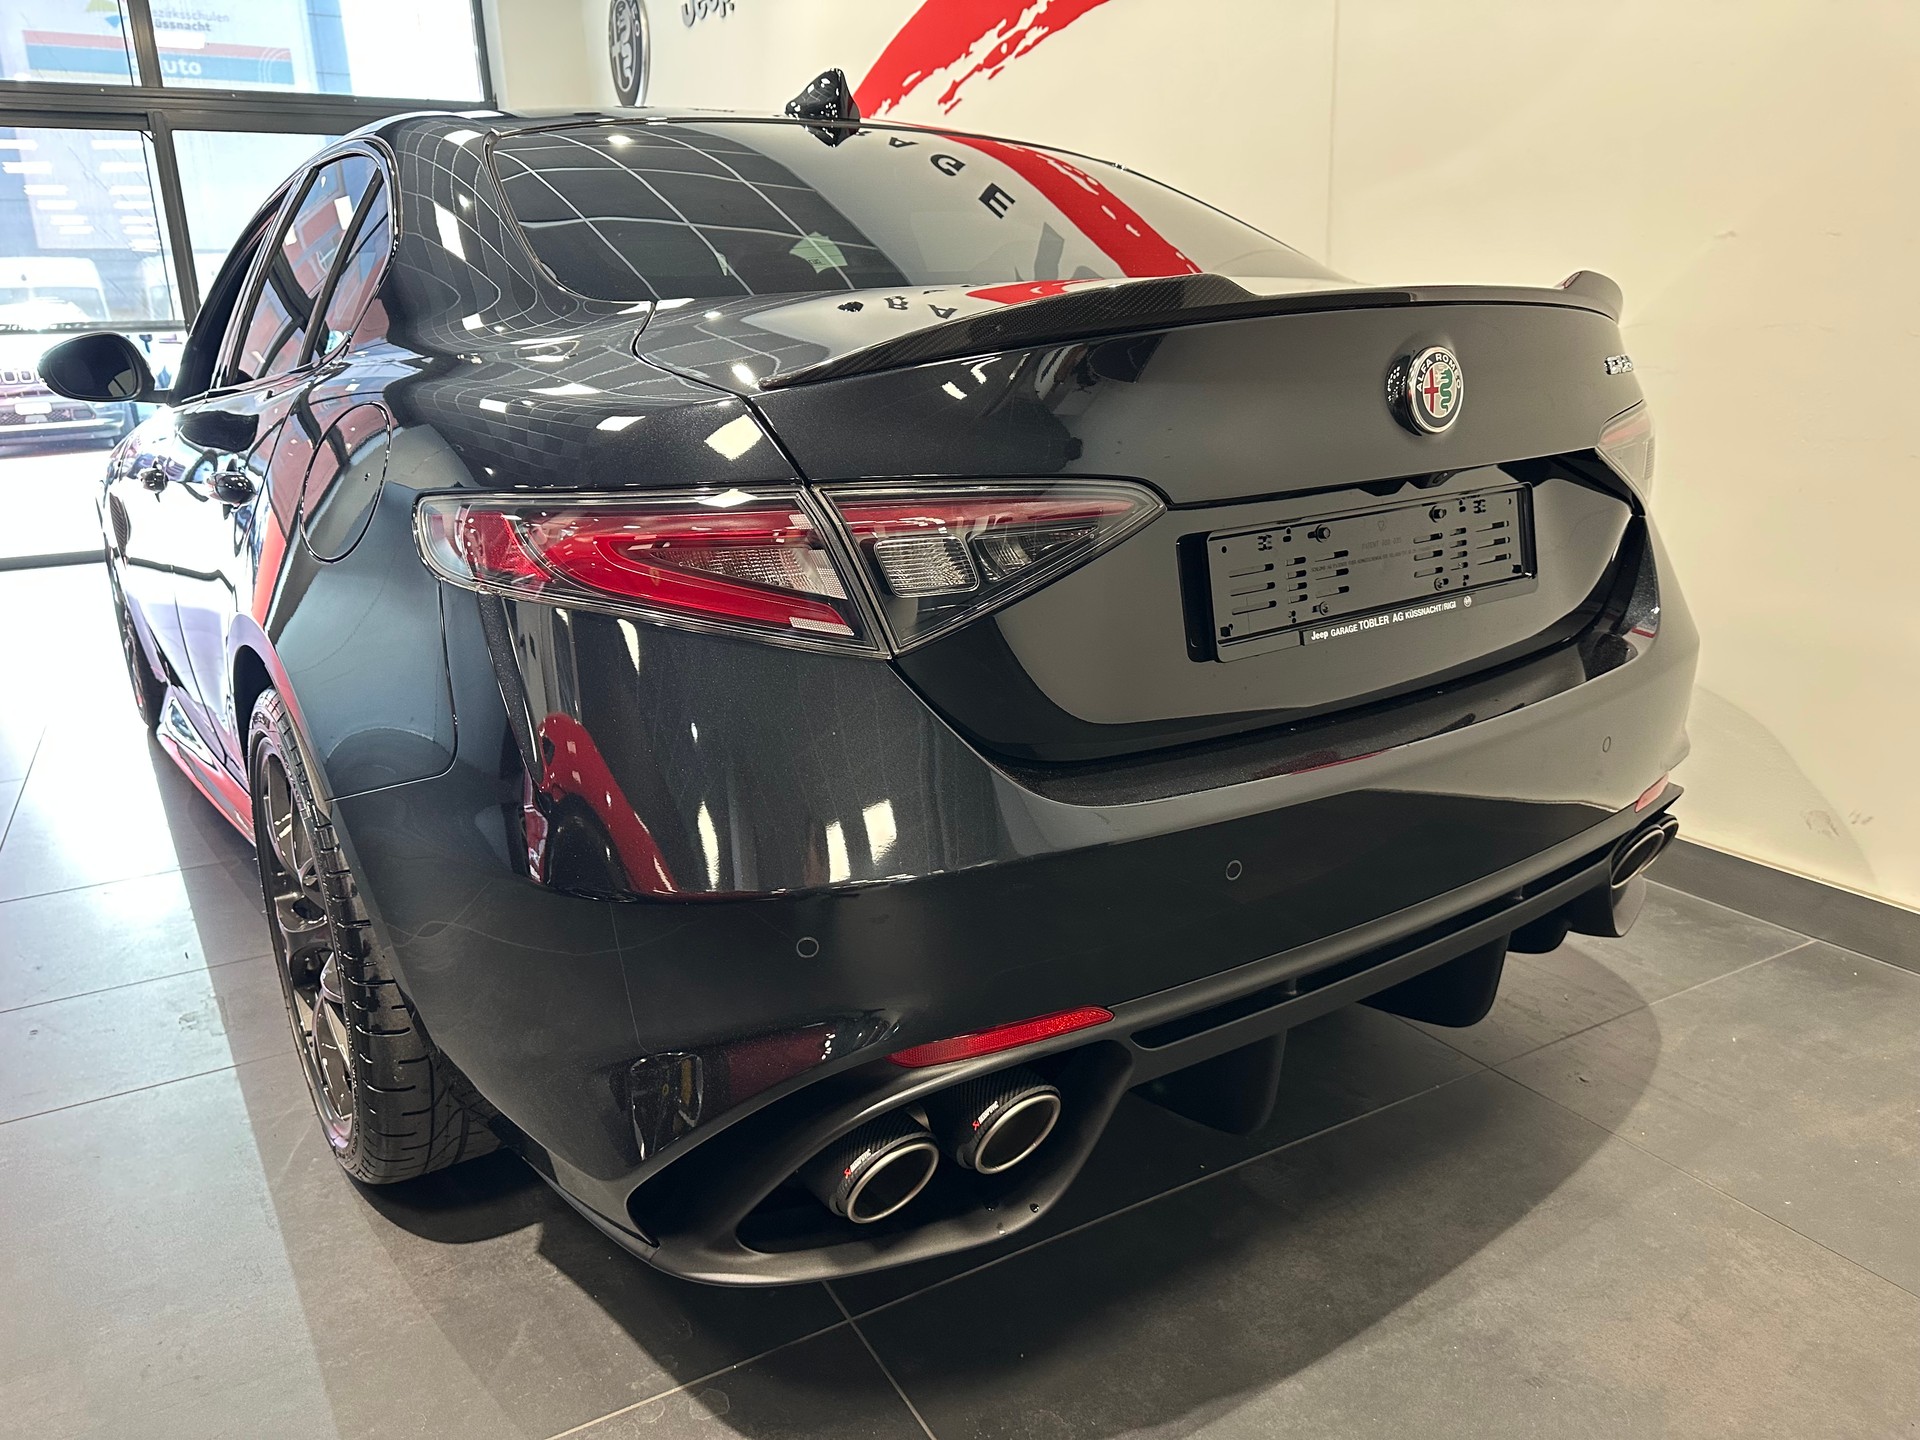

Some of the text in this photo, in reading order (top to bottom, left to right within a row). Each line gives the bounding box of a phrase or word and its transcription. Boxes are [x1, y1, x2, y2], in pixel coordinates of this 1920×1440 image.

[152, 8, 230, 22] ezirksschulen
[154, 18, 212, 32] üssnacht
[1416, 359, 1433, 393] ALFA
[1311, 630, 1329, 641] Jeep
[1331, 624, 1358, 636] GARAGE
[1358, 616, 1389, 630] TOBLER
[1392, 612, 1404, 623] AG
